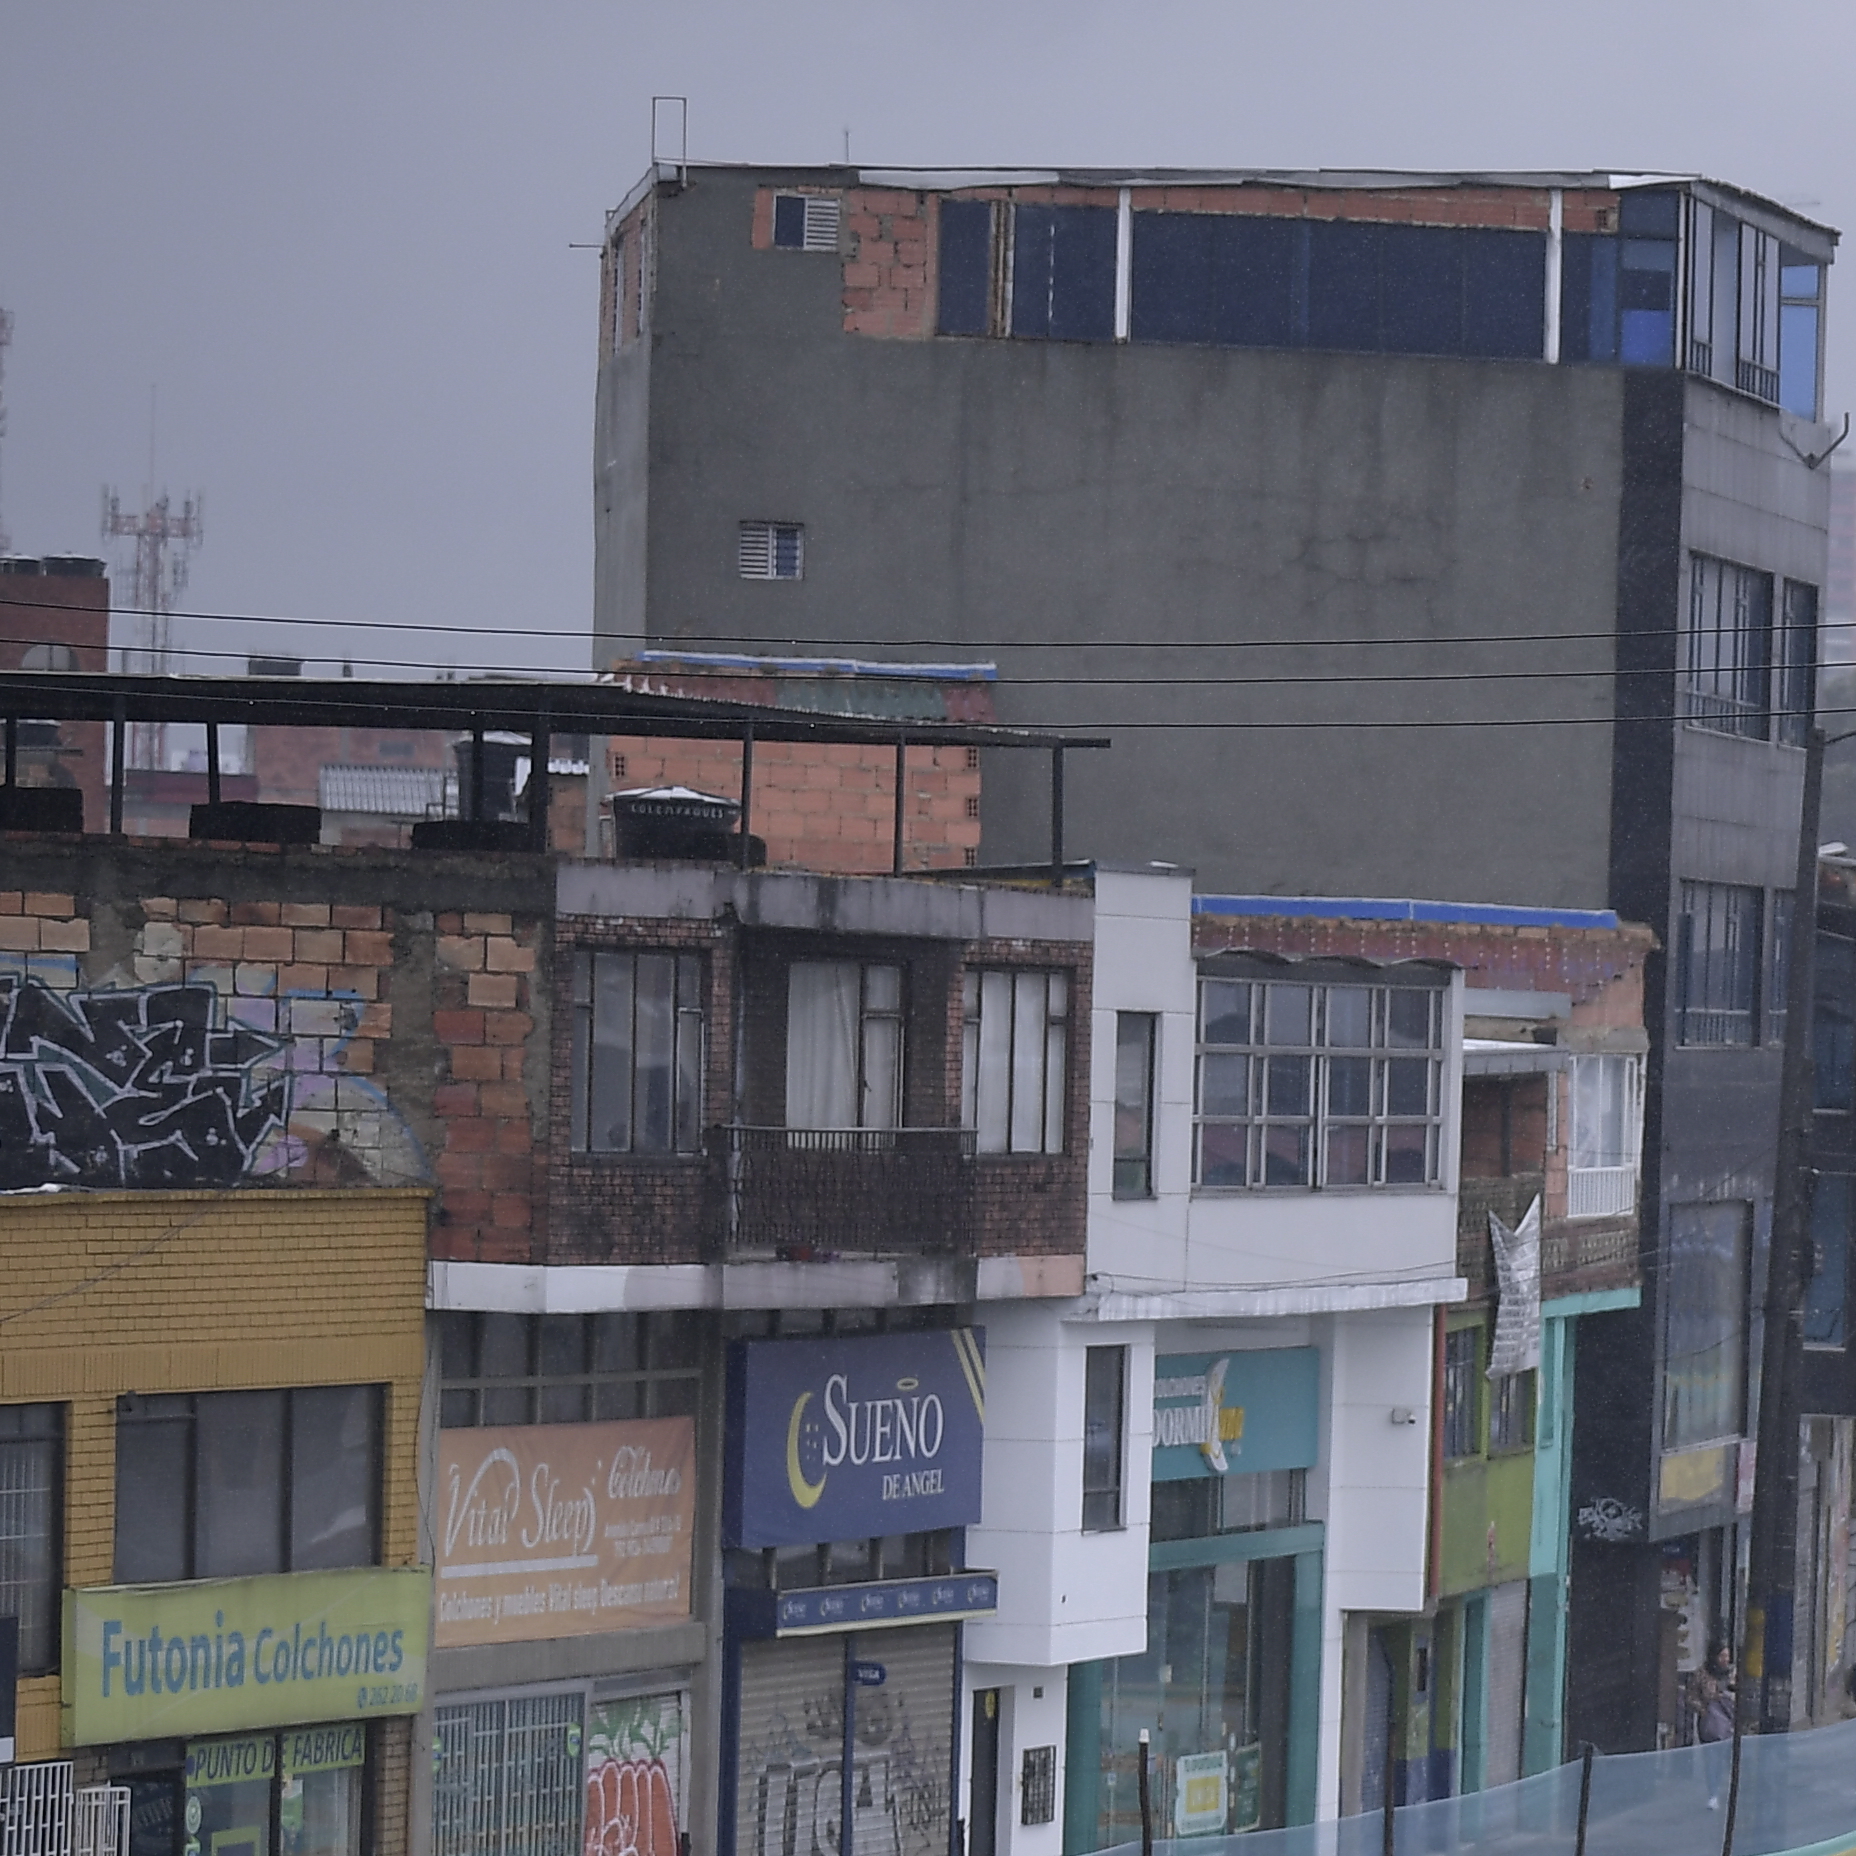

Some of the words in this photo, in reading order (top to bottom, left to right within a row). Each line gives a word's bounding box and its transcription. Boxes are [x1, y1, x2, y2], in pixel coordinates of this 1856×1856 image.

[444, 1447, 520, 1557] Vital
[521, 1463, 596, 1557] Sleep
[883, 1475, 900, 1500] DE
[902, 1469, 944, 1498] ANGEL
[101, 1609, 246, 1698] Futonia
[254, 1619, 405, 1685] Colchones
[195, 1743, 256, 1782] PUNTO
[292, 1727, 363, 1767] FABRICA
